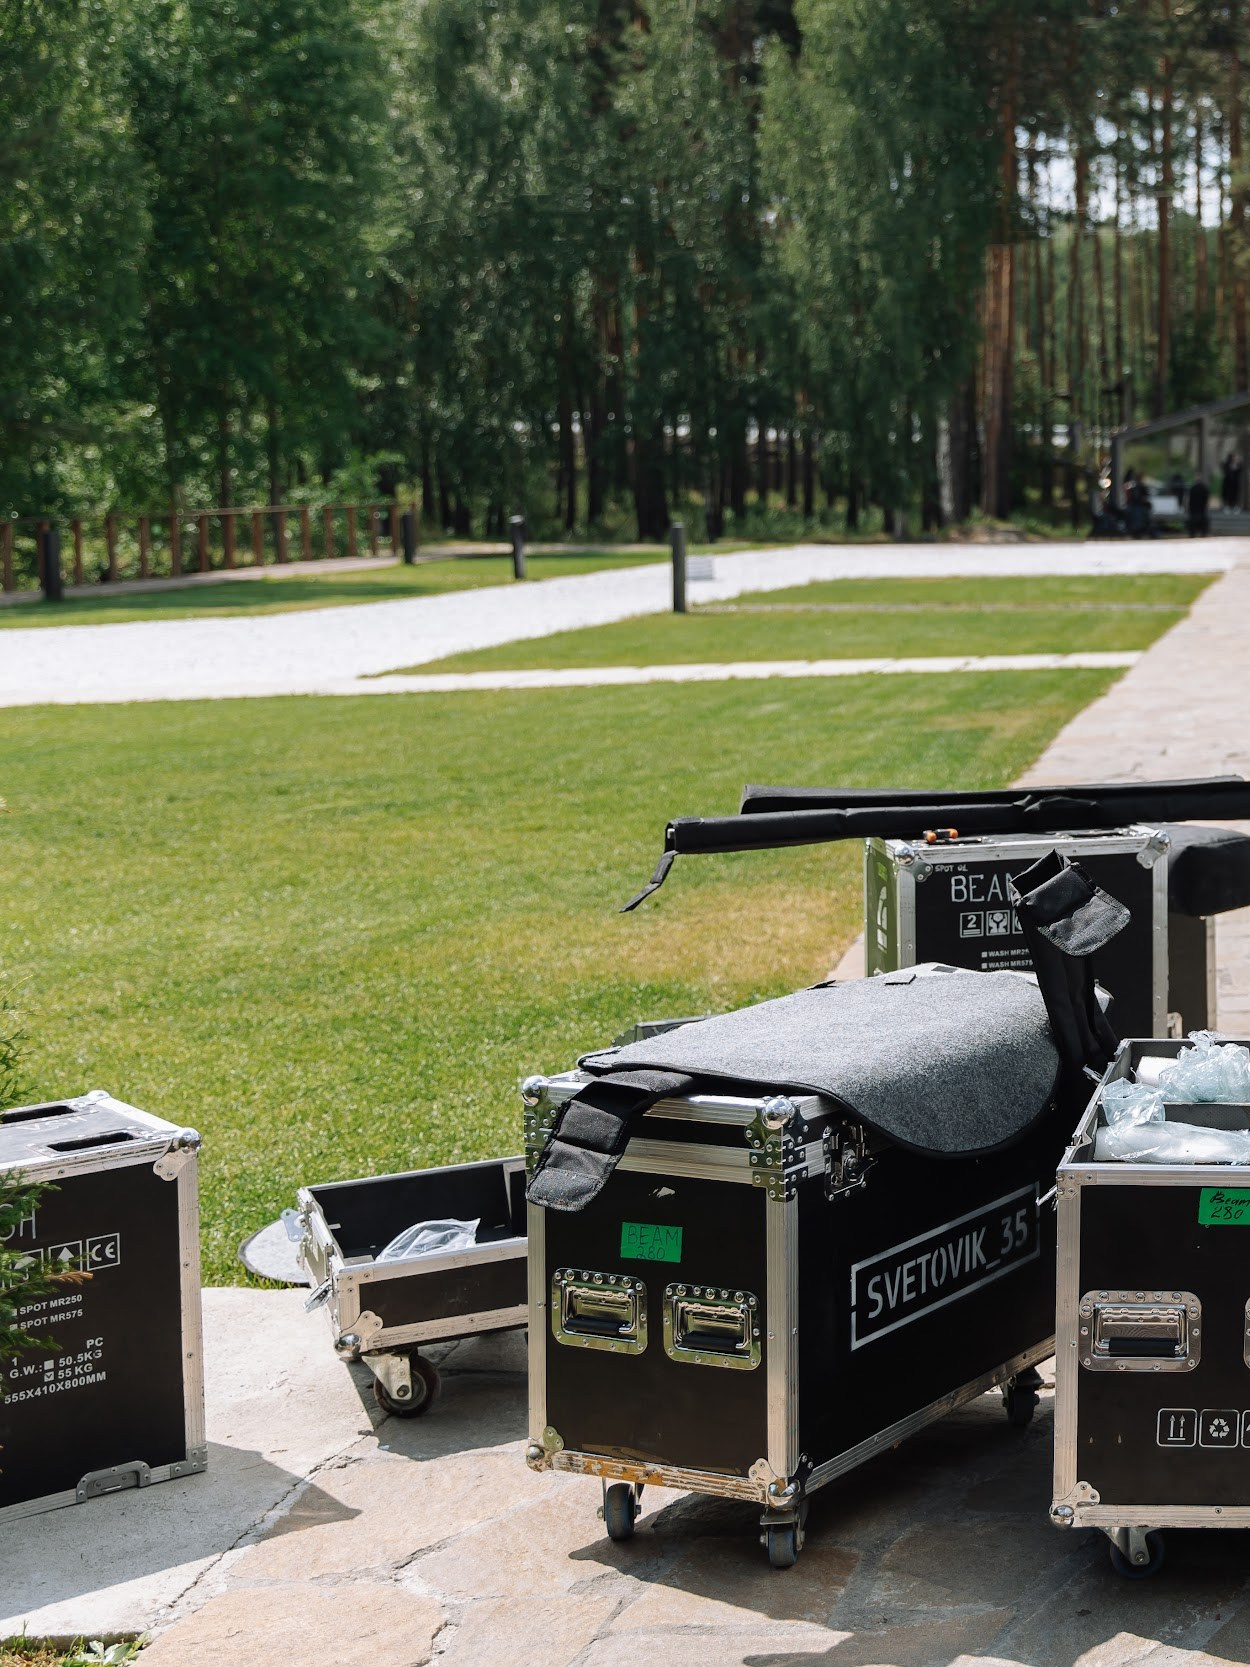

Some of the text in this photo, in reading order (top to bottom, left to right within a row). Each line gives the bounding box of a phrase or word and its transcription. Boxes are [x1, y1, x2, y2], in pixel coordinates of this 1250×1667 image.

[967, 915, 977, 928] 2
[988, 950, 1009, 958] WASH
[988, 961, 1009, 969] WASH
[1210, 1190, 1250, 1207] Beam
[1211, 1206, 1244, 1220] 280
[627, 1225, 679, 1247] BEAM
[91, 1241, 116, 1262] CE
[635, 1245, 666, 1260] 280
[20, 1294, 83, 1315] SPOT MR250
[20, 1309, 83, 1330] SPOT MR575
[11, 1337, 104, 1366] 1 PC
[59, 1350, 102, 1367] 50.5KG
[58, 1363, 93, 1379] 55 KG
[4, 1371, 107, 1405] 555X410X800MM
